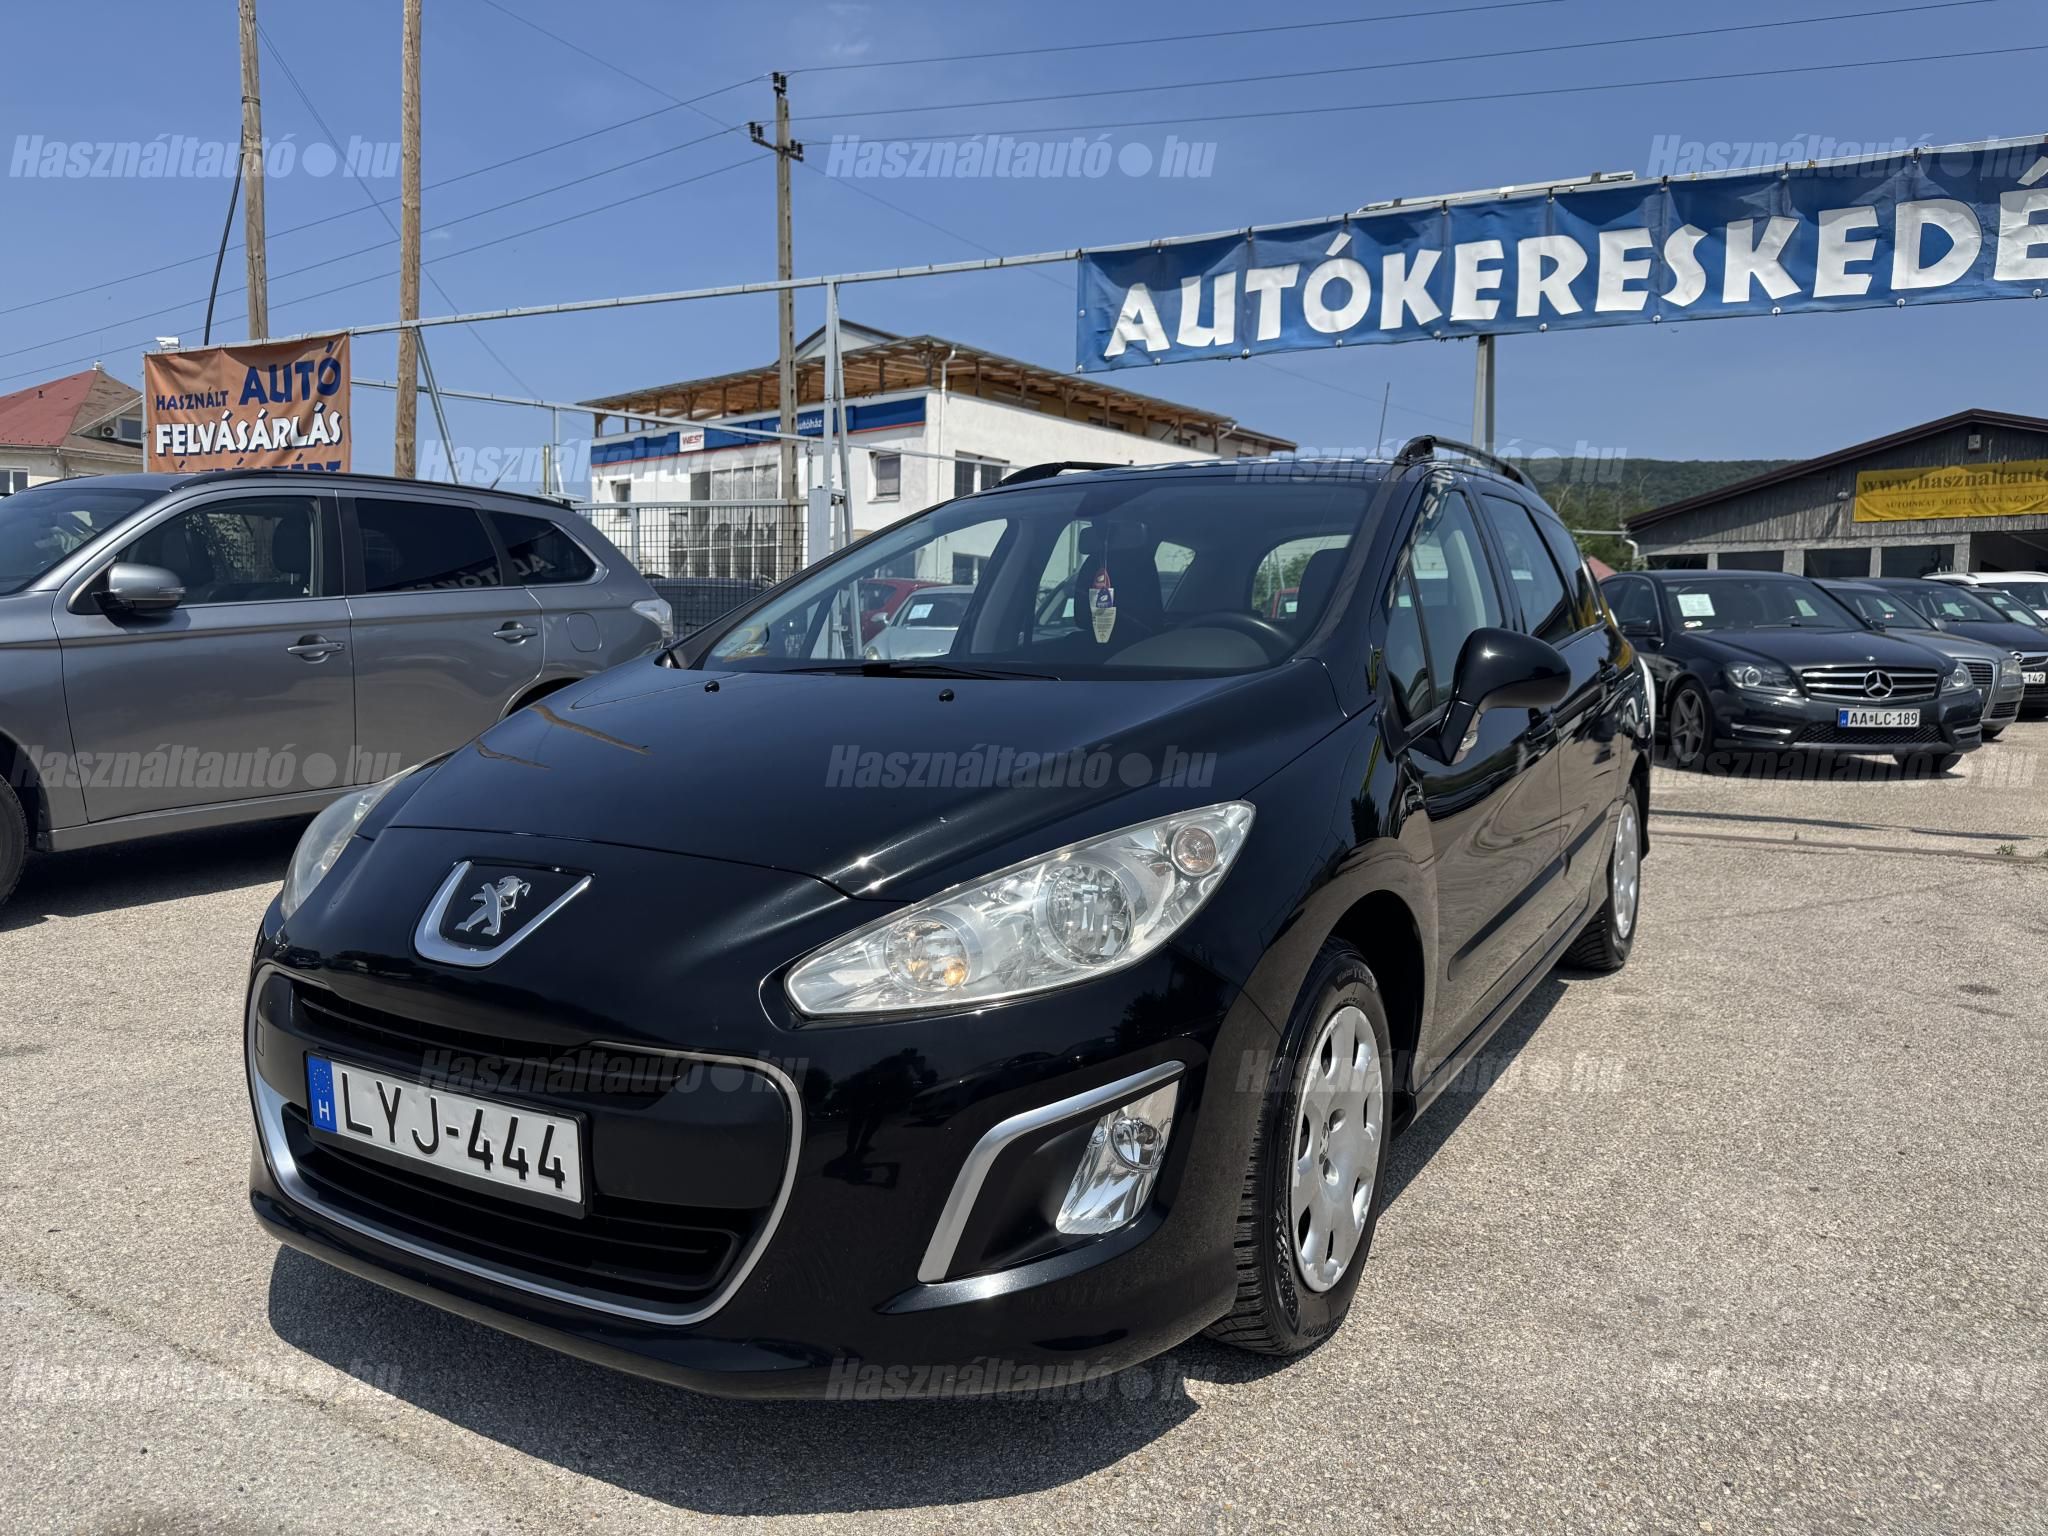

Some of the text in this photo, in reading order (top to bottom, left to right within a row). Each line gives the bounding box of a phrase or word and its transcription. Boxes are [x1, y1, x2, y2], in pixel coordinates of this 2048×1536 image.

[1104, 155, 2048, 357] AUTÓKERESKEDÉ
[156, 341, 341, 411] HASZNÁLT AUTÓ
[156, 401, 342, 456] FELVÁSÁRLÁS
[1850, 712, 1867, 725] AA
[1875, 712, 1918, 726] LC-189
[319, 1071, 566, 1190] H LYJ-444
